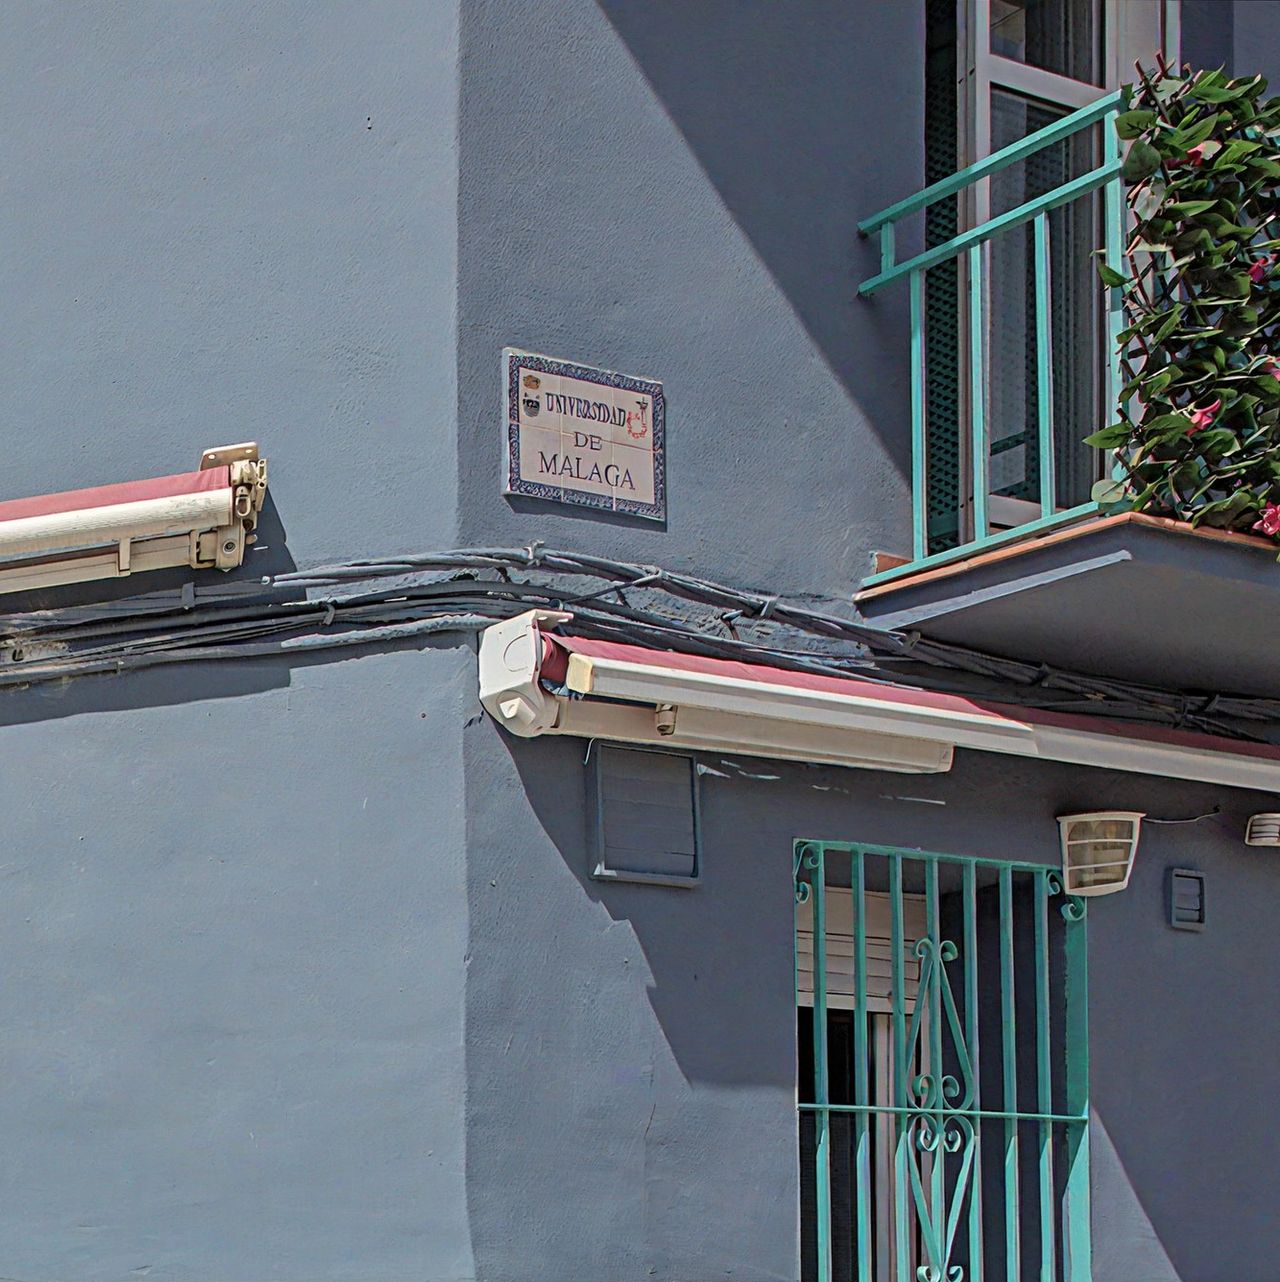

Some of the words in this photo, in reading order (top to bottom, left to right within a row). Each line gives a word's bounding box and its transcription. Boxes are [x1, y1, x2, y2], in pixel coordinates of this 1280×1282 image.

[545, 392, 627, 428] UNIVERSIDAD
[573, 431, 603, 451] DE
[538, 451, 636, 491] MALAGA
